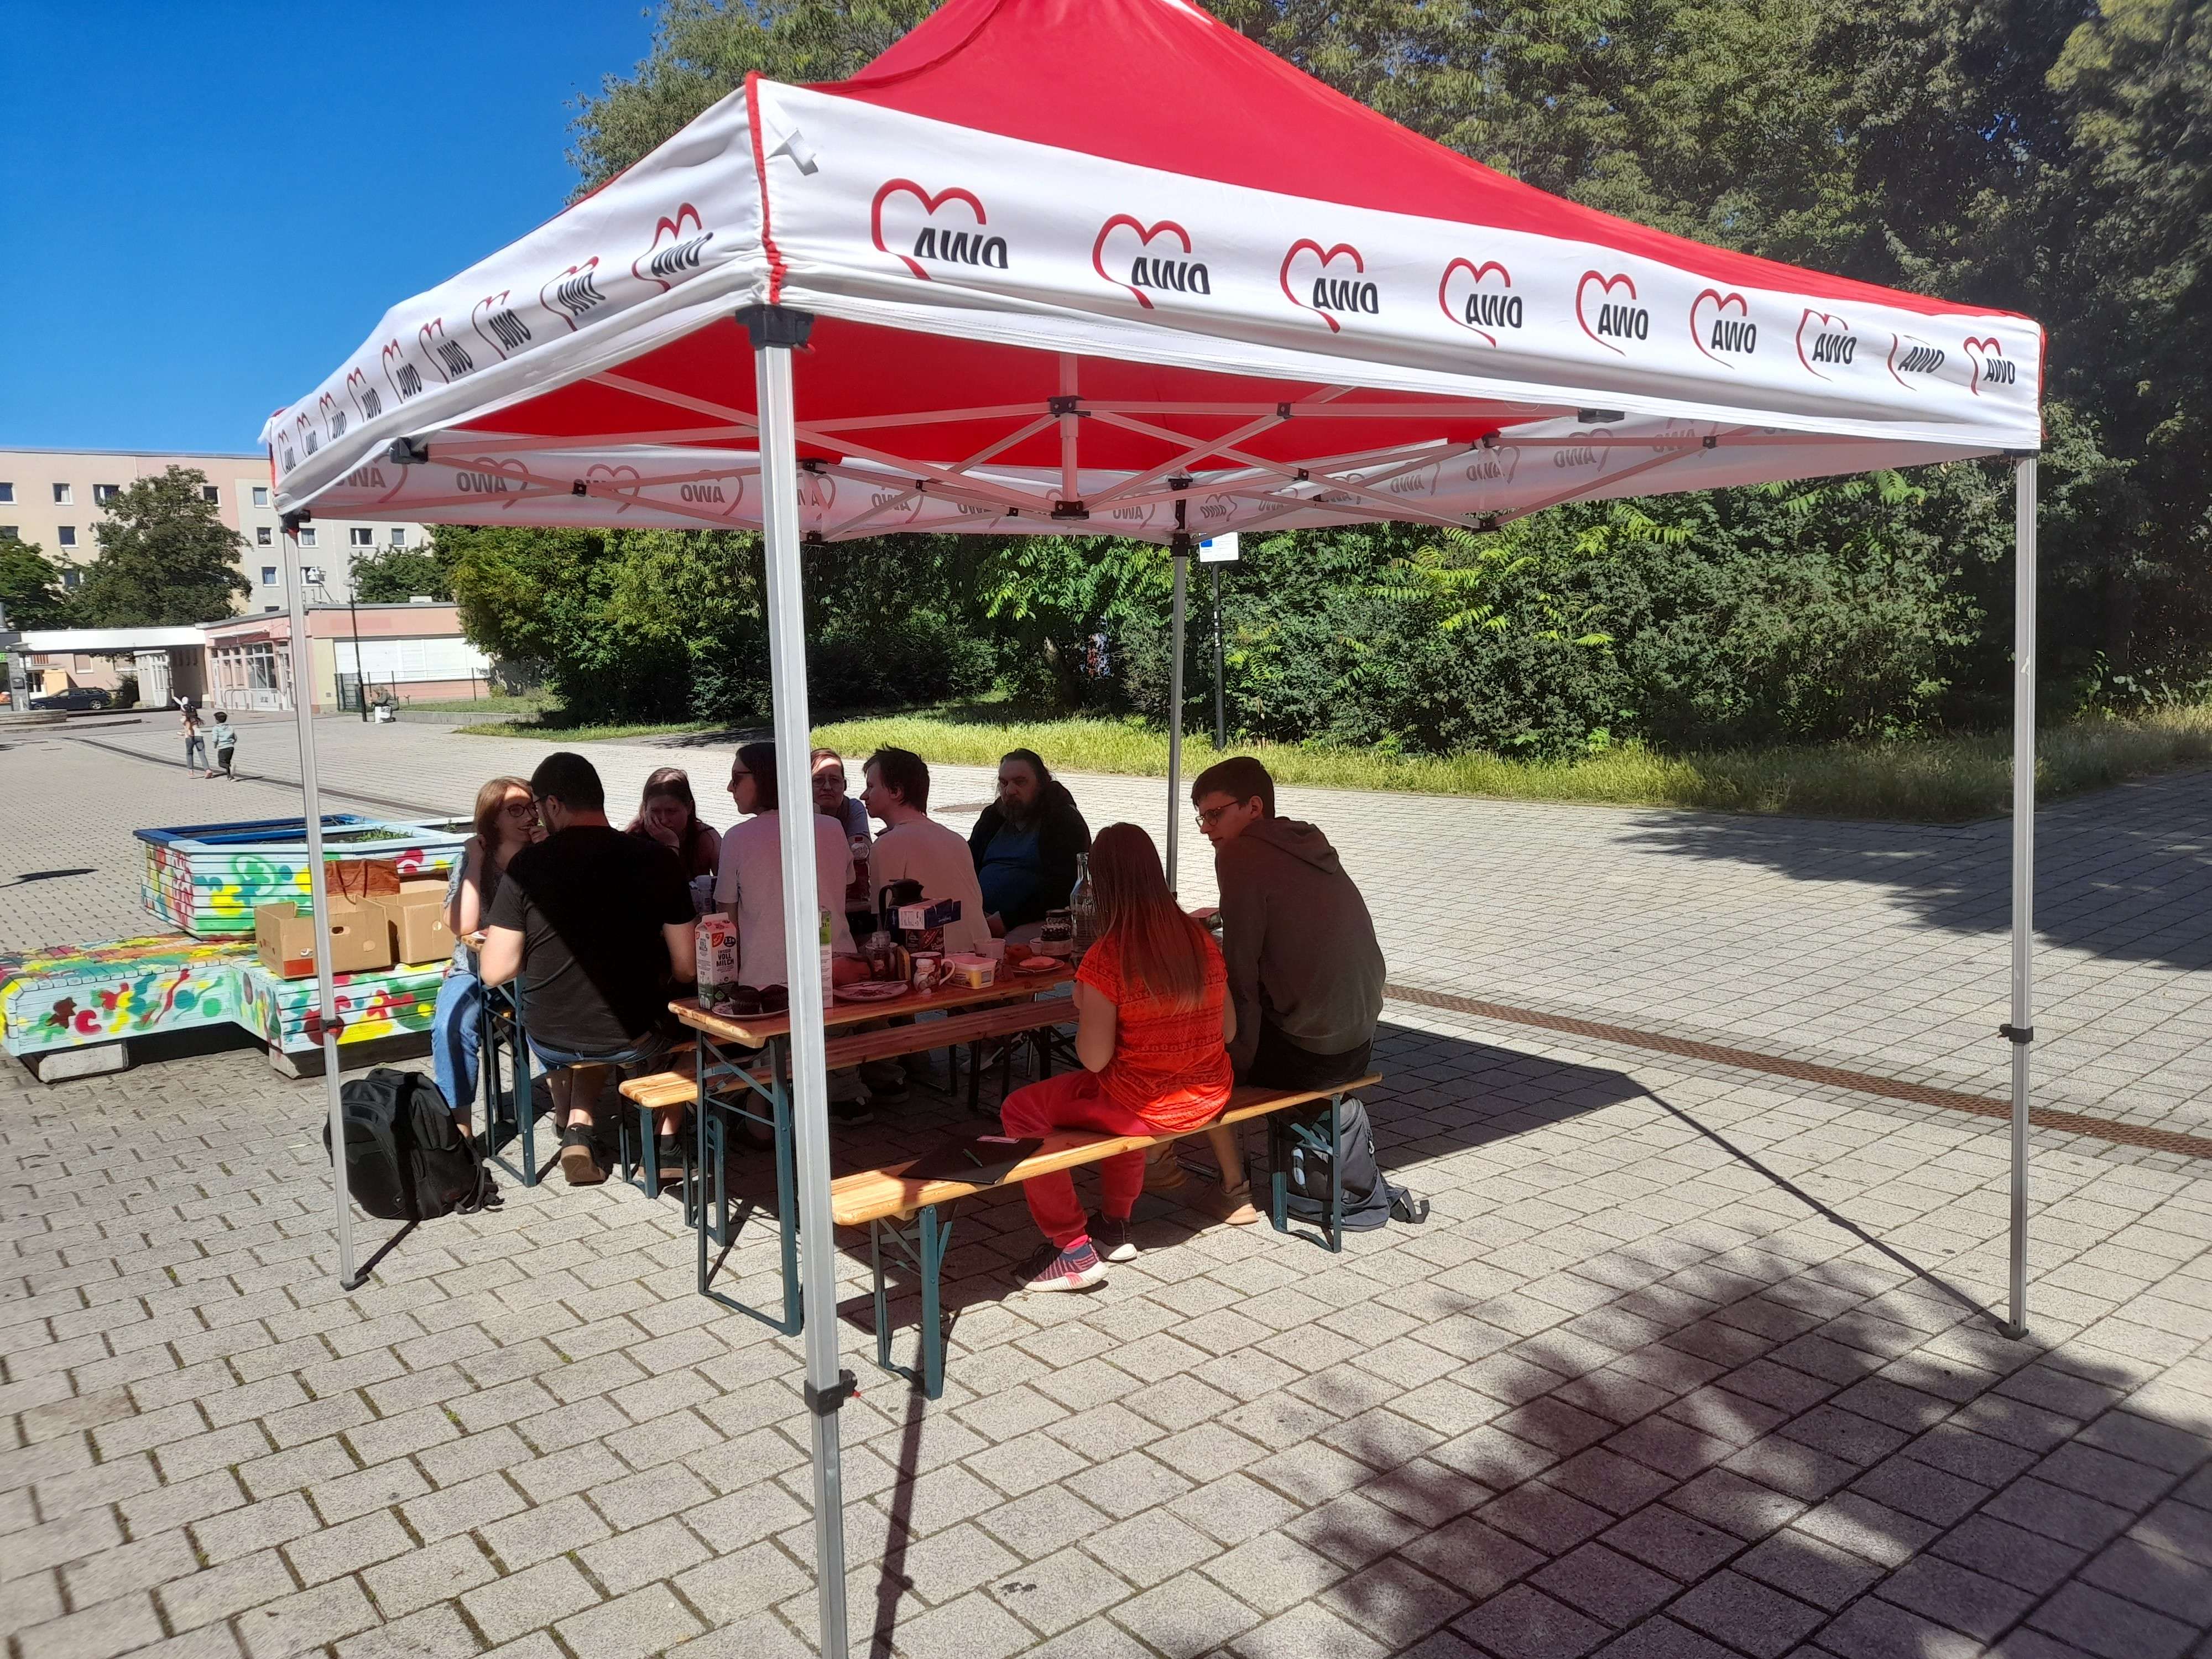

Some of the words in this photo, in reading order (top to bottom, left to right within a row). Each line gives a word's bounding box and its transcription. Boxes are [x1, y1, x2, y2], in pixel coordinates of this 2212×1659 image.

[651, 232, 714, 277] AWO
[913, 227, 1009, 269] AWO
[1131, 257, 1211, 295] AWO
[557, 271, 606, 316] AWO
[1312, 278, 1379, 314] AWO
[1465, 294, 1522, 328] AWO
[1597, 304, 1648, 341] AWO
[488, 309, 532, 351] AWO
[1711, 320, 1757, 354] AWO
[436, 339, 473, 377] AWO
[1811, 333, 1857, 364] AWO
[1897, 346, 1945, 374] AWO
[396, 362, 422, 399] AWO
[1983, 358, 2016, 385] AWO
[361, 387, 382, 420] AWO
[331, 410, 347, 440] AWO
[305, 429, 319, 456] AWO
[284, 446, 296, 475] AWO
[716, 958, 734, 967] MILCH
